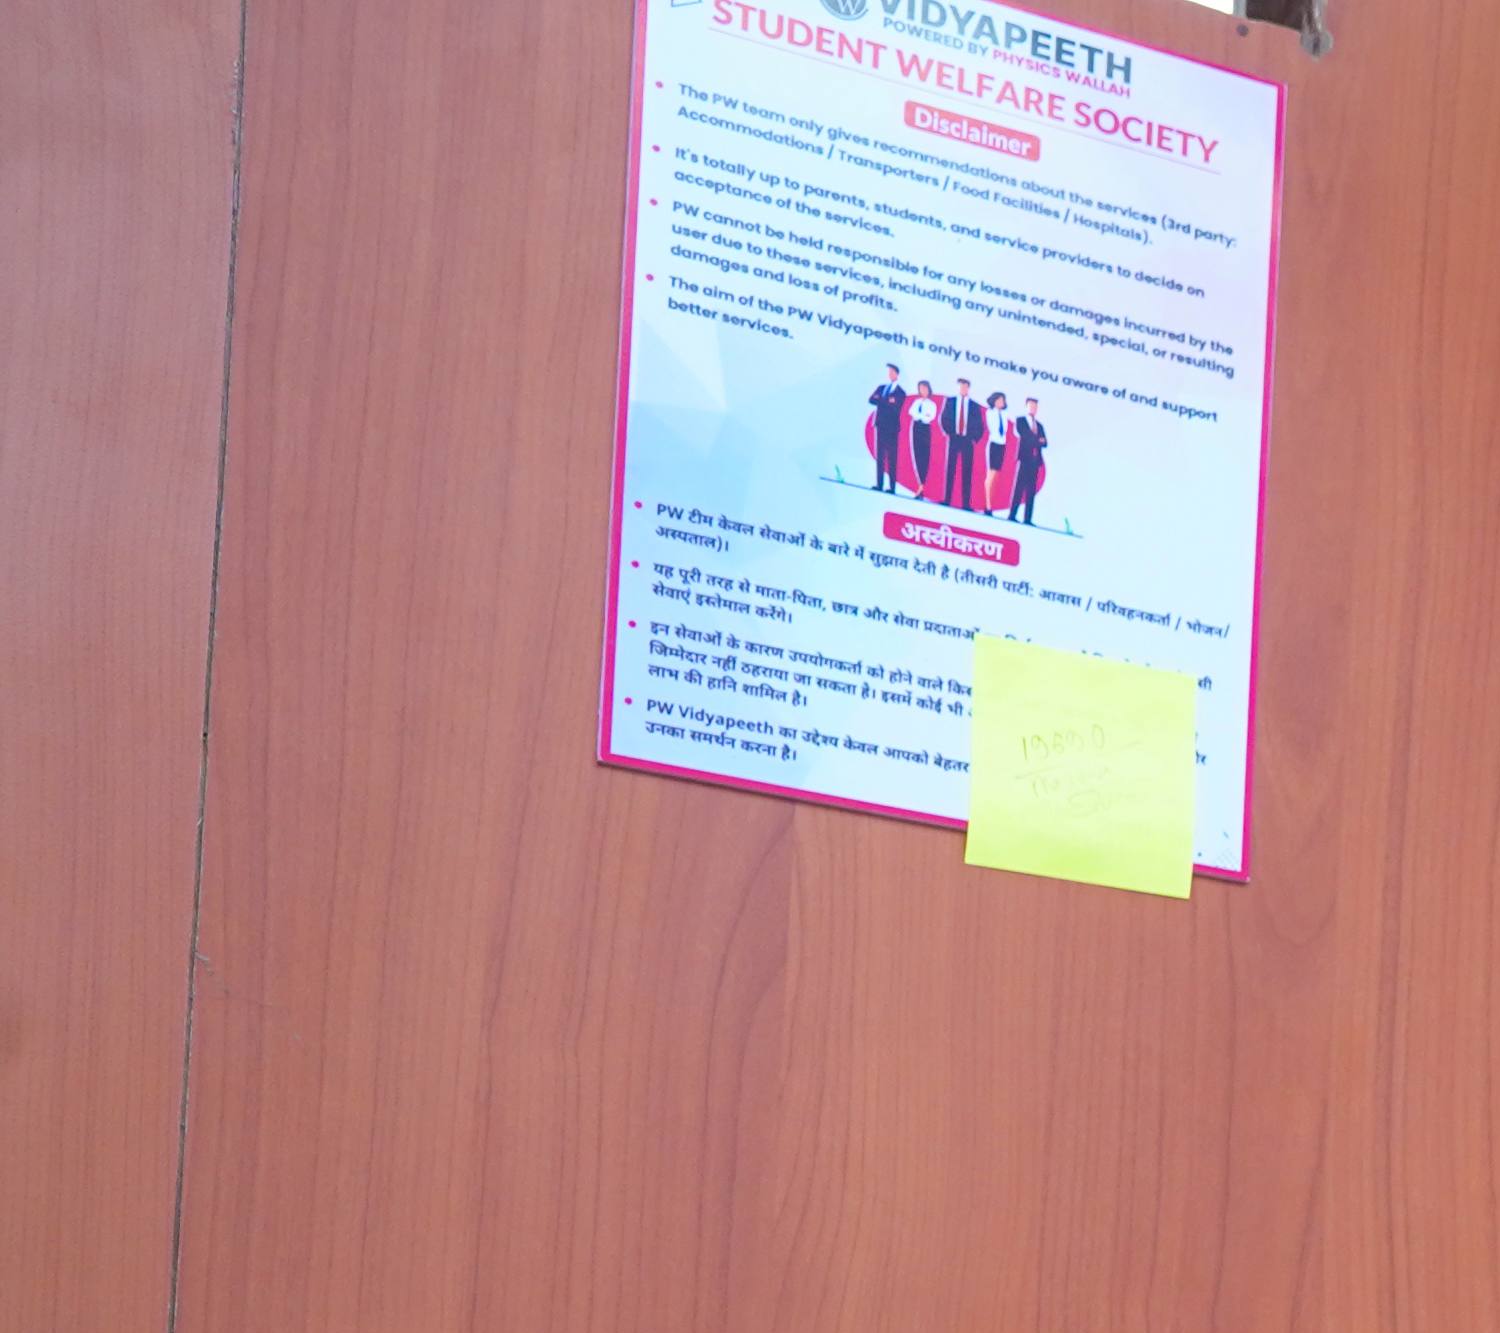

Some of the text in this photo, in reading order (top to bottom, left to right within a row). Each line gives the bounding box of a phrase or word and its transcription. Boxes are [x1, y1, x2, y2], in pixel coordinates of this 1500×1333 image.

[712, 0, 1219, 163] STUDENT WELFARE SOCIETY
[883, 17, 1132, 99] POWERED BY PHYSICS WALLAH
[677, 105, 824, 156] Accommodations
[839, 149, 939, 187] Transporters
[952, 180, 989, 201] Food
[993, 191, 1060, 219] Facilities
[679, 82, 709, 102] The
[711, 92, 739, 110] PW
[741, 101, 786, 123] team
[788, 116, 824, 137] only
[826, 126, 871, 147] gives
[872, 139, 1018, 187] recommendations
[1019, 179, 1066, 200] about
[1068, 191, 1094, 208] the
[1096, 200, 1158, 225] services
[914, 106, 1032, 157] Disclaimer
[673, 170, 894, 237] acceptance of the services.
[701, 153, 757, 182] totally
[758, 171, 781, 188] up
[783, 176, 801, 191] to
[802, 183, 870, 211] parents,
[872, 202, 947, 231] students,
[949, 223, 982, 239] and
[983, 231, 1040, 254] service
[1041, 247, 1114, 273] providers
[1115, 264, 1132, 278] to
[1133, 270, 1184, 292] decide
[1185, 285, 1205, 298] on
[667, 296, 793, 339] better services.
[669, 243, 897, 312] damages and loss of profits.
[671, 200, 1233, 356] PW cannot be held responsible for any losses or damages incurred by the
[671, 223, 1235, 380] user due to these services, including any unintended, special, or resulting
[669, 275, 1217, 422] The aim of the PW Vidyapeeth is only to make you aware of and support
[901, 522, 1004, 560] अस्वीकरण
